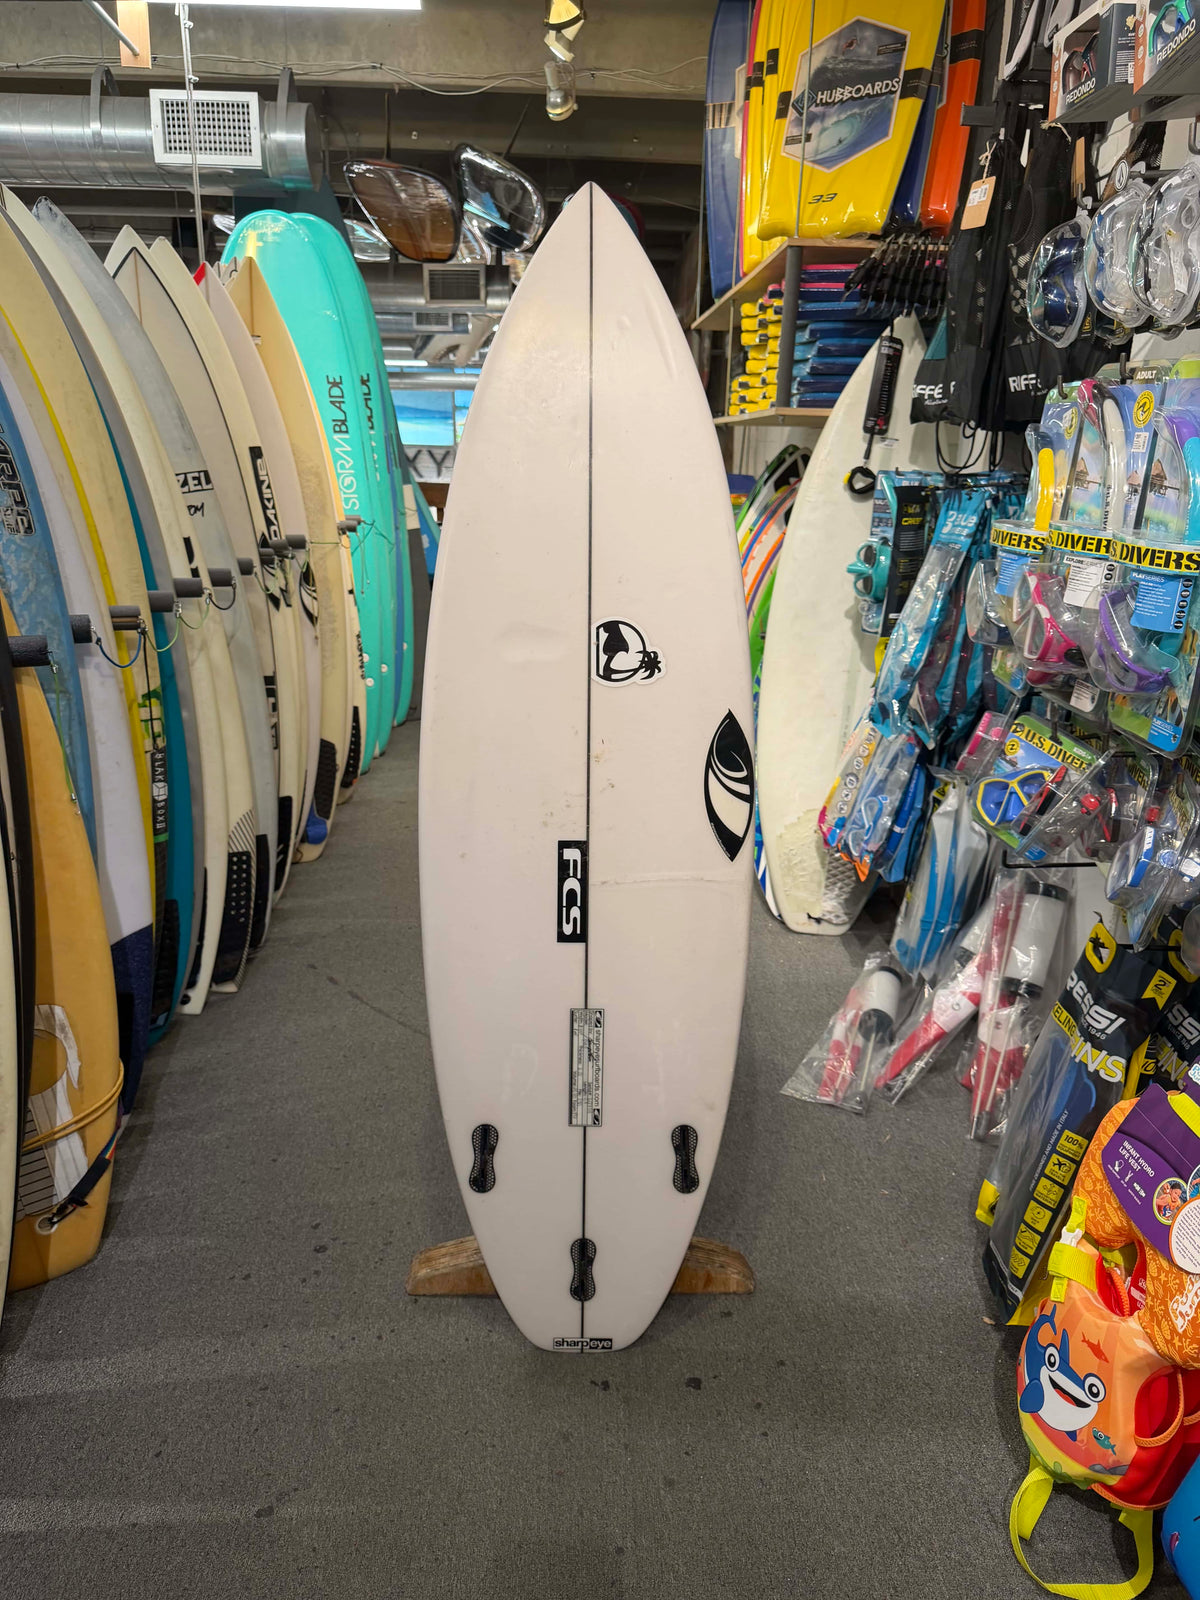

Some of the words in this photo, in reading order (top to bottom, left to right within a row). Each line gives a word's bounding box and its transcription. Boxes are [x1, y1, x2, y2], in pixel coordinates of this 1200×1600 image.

[1157, 18, 1196, 64] REDONDO
[817, 78, 901, 104] HUBBOARDS
[1065, 77, 1096, 105] REDONDO
[808, 193, 838, 205] 33
[1135, 370, 1157, 380] ADULT
[326, 374, 360, 511] STORMBLADE
[992, 529, 1047, 551] DIVERS
[1119, 543, 1200, 572] DIVERS
[1025, 729, 1047, 750] U.S.
[563, 848, 581, 936] FCS
[1154, 979, 1166, 991] 2
[1053, 1002, 1078, 1037] ELING
[1064, 1135, 1085, 1150] 100%
[1119, 1146, 1131, 1161] LIFE
[1127, 1156, 1141, 1172] VEST
[1123, 1140, 1141, 1163] INFANT
[1139, 1156, 1155, 1178] HYDRO
[554, 1338, 612, 1350] sharpeye
